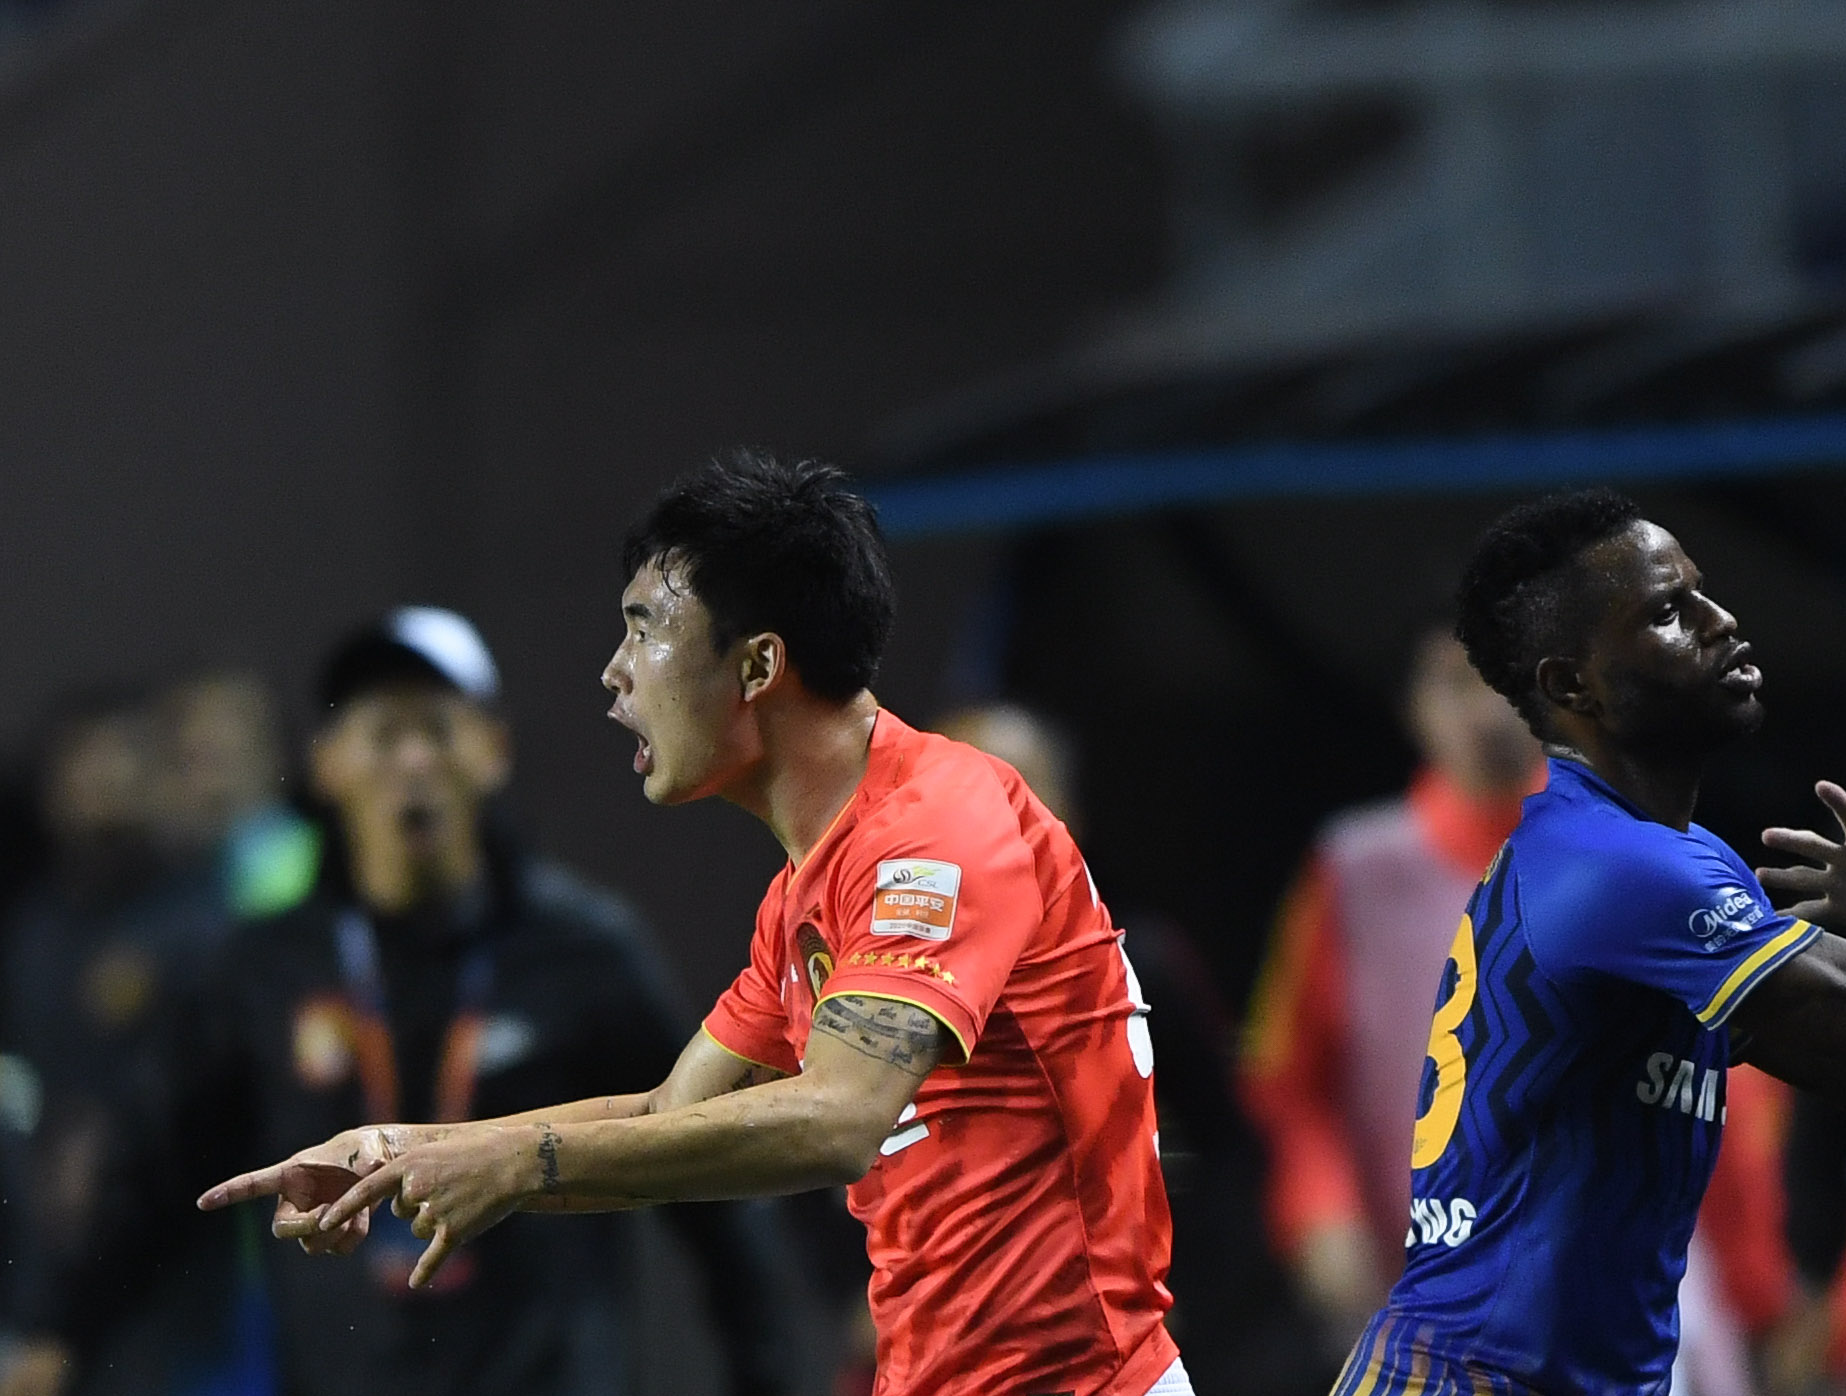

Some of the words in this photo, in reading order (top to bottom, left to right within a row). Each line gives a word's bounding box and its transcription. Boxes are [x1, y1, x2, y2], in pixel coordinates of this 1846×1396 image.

[884, 893, 945, 912] 中国平安
[1702, 892, 1754, 933] Midea
